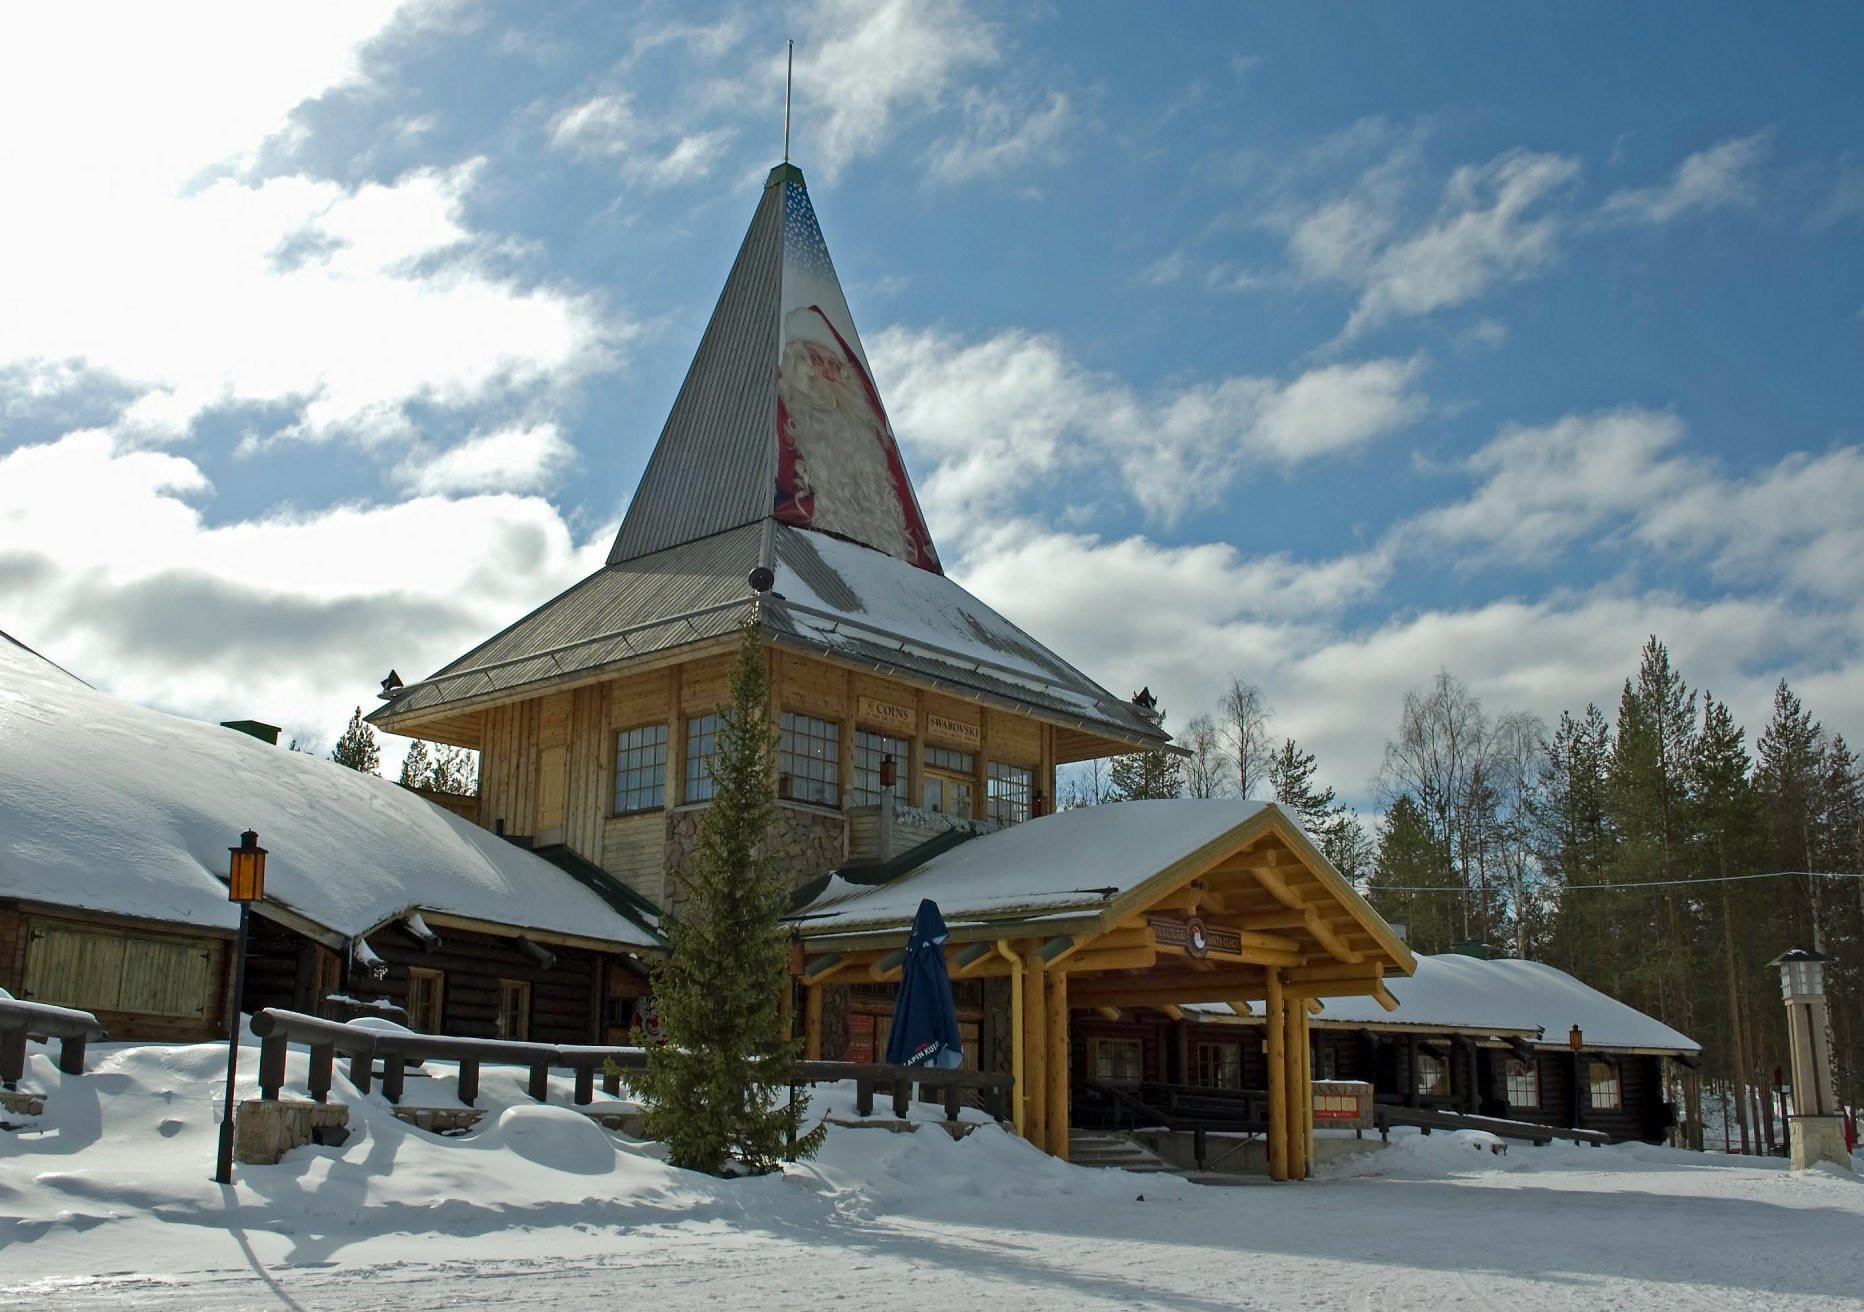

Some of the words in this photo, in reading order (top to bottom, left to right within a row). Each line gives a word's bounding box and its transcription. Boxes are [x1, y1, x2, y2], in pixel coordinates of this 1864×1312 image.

[876, 703, 909, 721] COINS
[930, 715, 979, 738] SWAROVSKI
[903, 1050, 925, 1067] APIN
